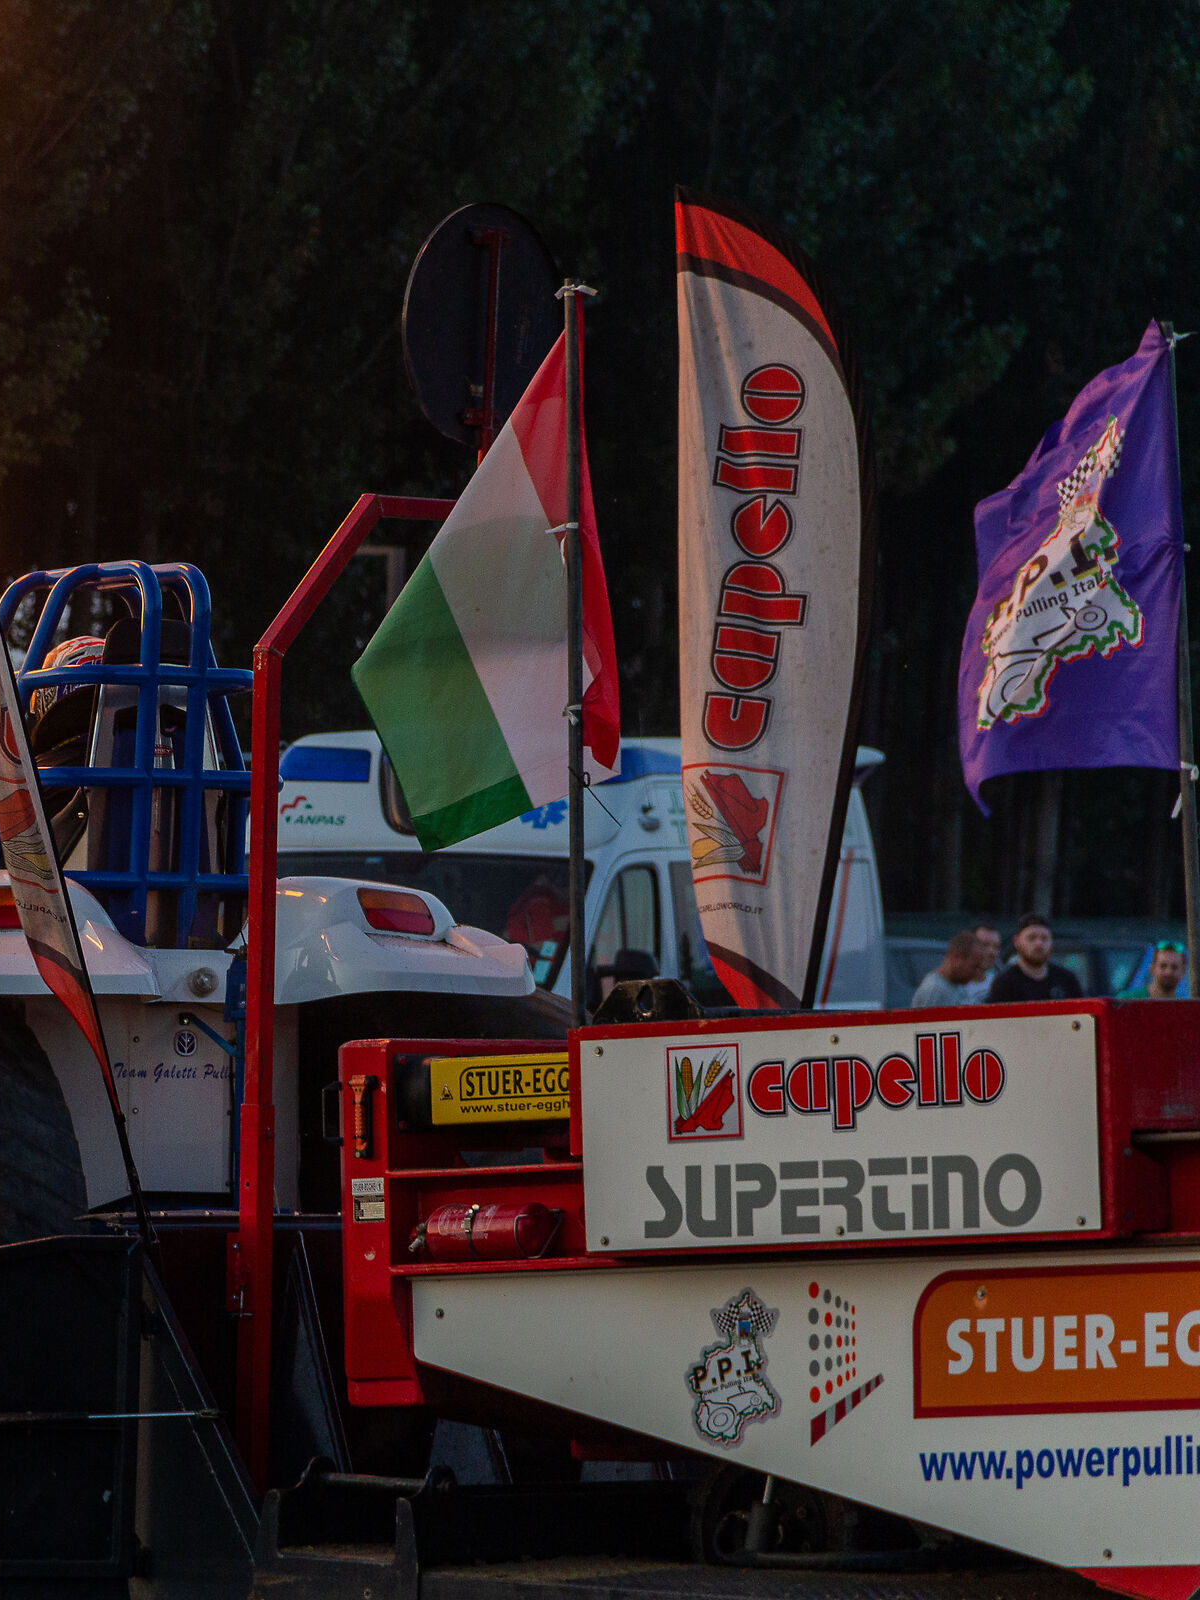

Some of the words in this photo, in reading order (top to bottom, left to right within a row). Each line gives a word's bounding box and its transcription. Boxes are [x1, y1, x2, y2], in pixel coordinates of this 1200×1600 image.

[702, 363, 808, 752] capello
[293, 815, 346, 827] ANPAS
[113, 1062, 148, 1079] Team
[153, 1062, 198, 1083] Galetti
[465, 1067, 569, 1097] STUER-EGG
[747, 1031, 1006, 1131] capello
[693, 1349, 762, 1391] P.P.I.
[919, 1435, 1200, 1490] www.powerpulli
